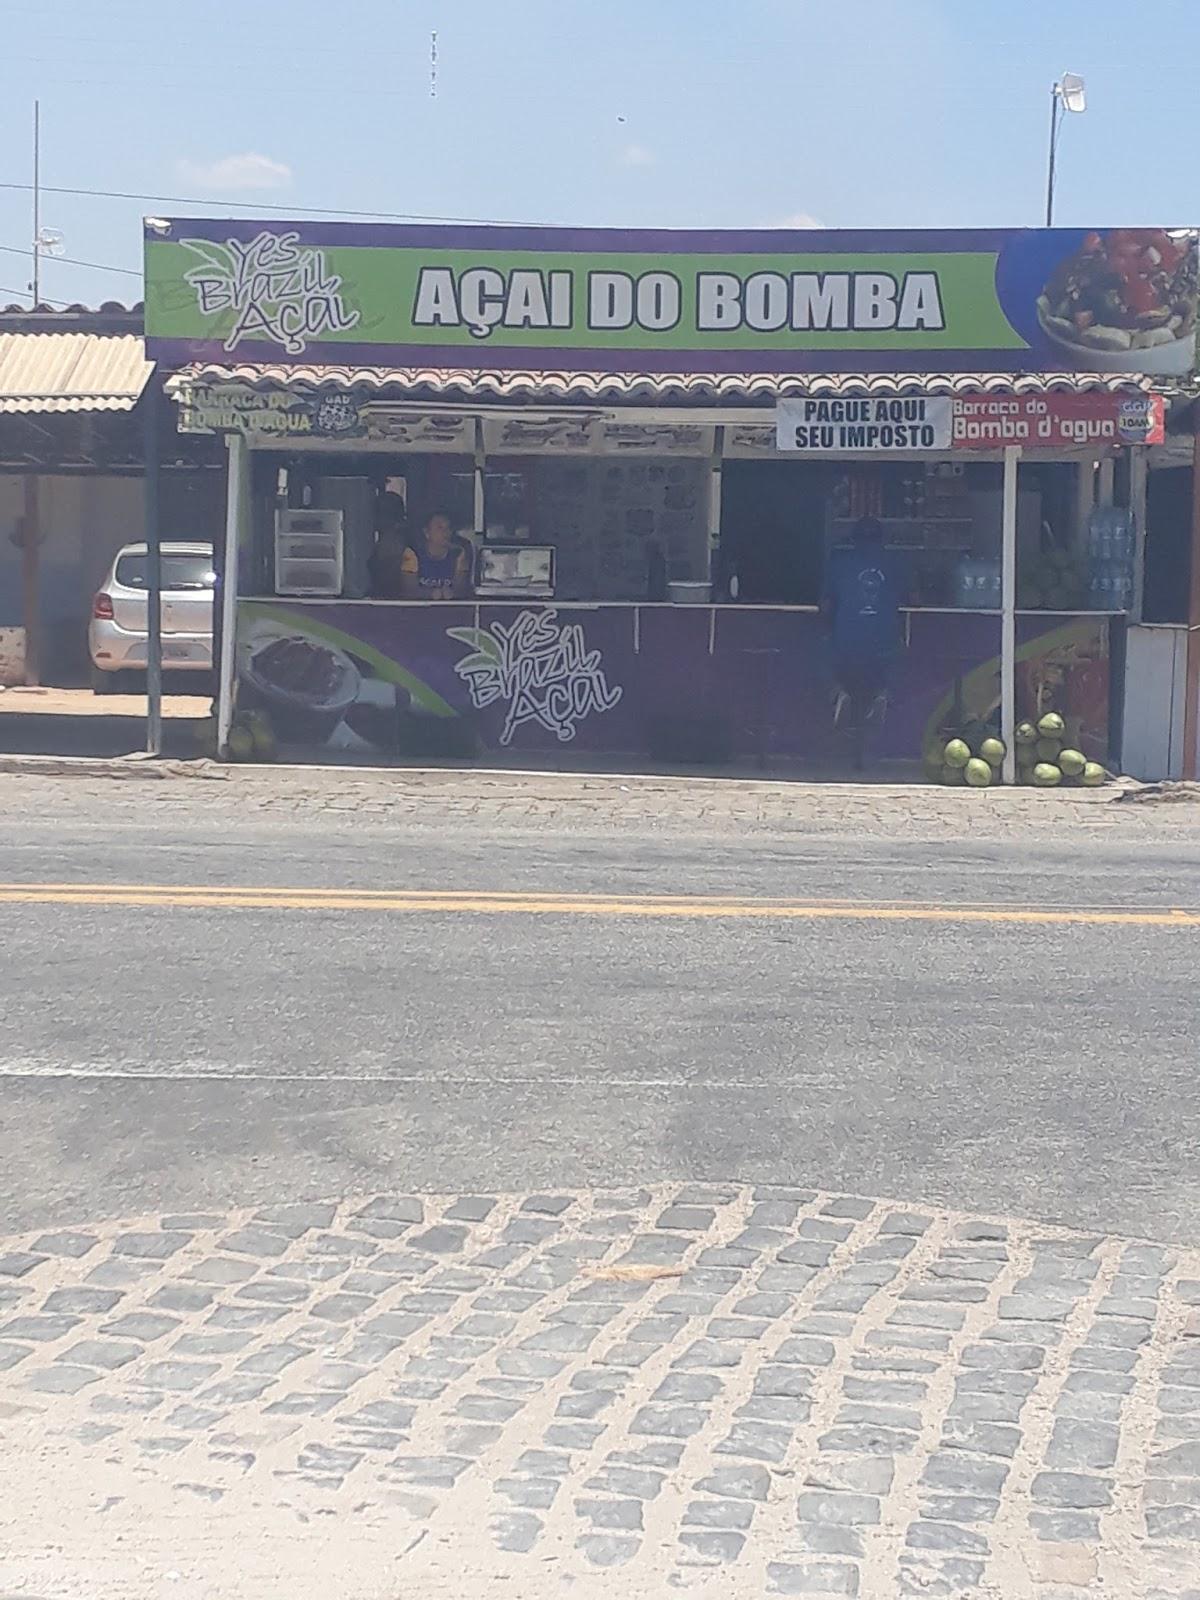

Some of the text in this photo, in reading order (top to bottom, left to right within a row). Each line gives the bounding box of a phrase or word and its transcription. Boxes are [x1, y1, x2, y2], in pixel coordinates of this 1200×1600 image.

[190, 249, 336, 316] Brazil
[226, 230, 301, 287] Yes
[411, 266, 947, 337] AÇAI DO BOMBA
[794, 425, 935, 449] SEU IMPOSTO
[803, 399, 926, 423] PAGUE AQUI
[952, 416, 1030, 440] Bomba
[459, 624, 600, 708] Brazil
[490, 608, 561, 668] Yes
